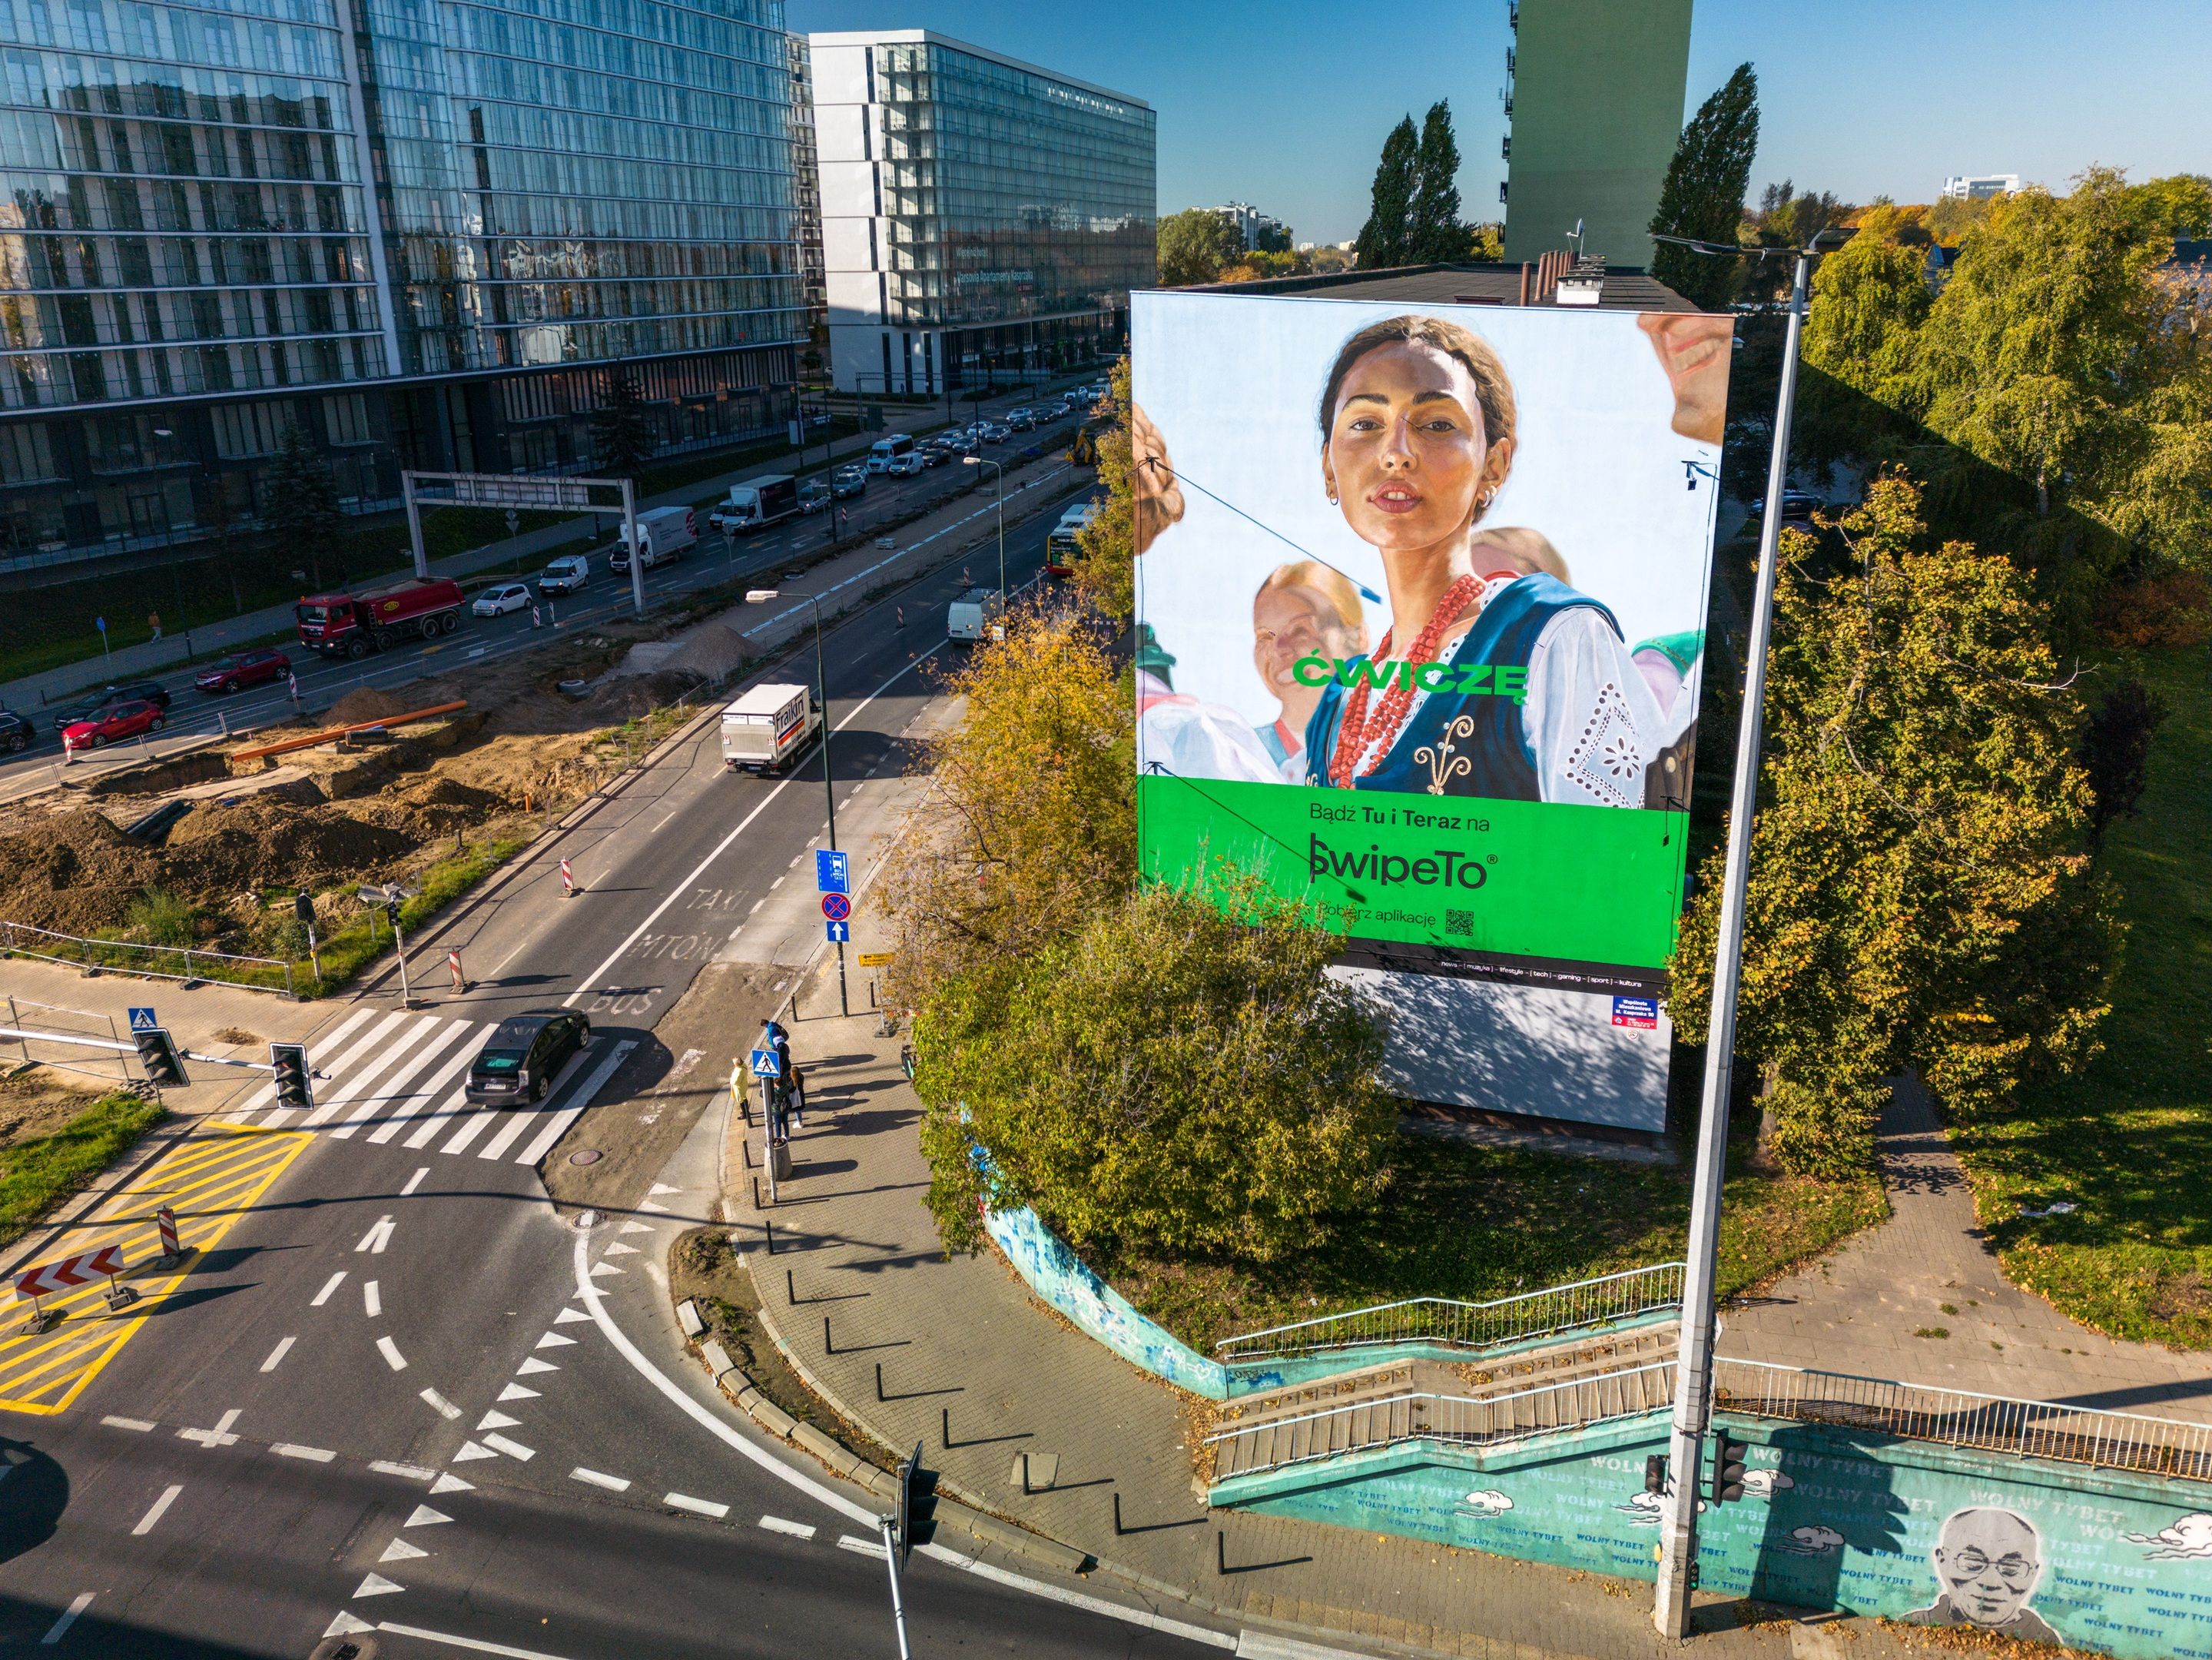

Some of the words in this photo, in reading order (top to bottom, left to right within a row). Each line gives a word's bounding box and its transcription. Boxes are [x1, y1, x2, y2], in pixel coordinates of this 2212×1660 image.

[957, 271, 979, 284] Varsovia
[980, 271, 1010, 283] Apartamenty
[1011, 269, 1033, 283] Kasprzaka
[1292, 648, 1529, 706] ĆWICZĘ
[776, 693, 804, 732] Fraikin
[1310, 803, 1356, 824] Bądź
[1361, 807, 1385, 824] Tu
[1391, 808, 1396, 825] i
[1402, 809, 1461, 830] Teraz
[1467, 818, 1490, 832] na
[686, 888, 749, 911] TAXI
[1375, 909, 1436, 928] aplikację
[627, 935, 722, 960] MTON
[1499, 967, 1524, 975] lifestyle
[1557, 973, 1581, 982] gaming
[585, 986, 662, 1014] BUS
[1591, 1456, 1647, 1475] WOLN
[1753, 1447, 1822, 1469] WOLNY
[1832, 1459, 1897, 1479] TYBET
[1556, 1494, 1603, 1509] WOLNY
[1793, 1483, 1862, 1502] WOLNY
[1872, 1492, 1936, 1512] TYBET
[1357, 1499, 1388, 1510] WOLNY
[1392, 1505, 1421, 1515] TYBET
[1428, 1506, 1458, 1517] WOLN
[1728, 1508, 1774, 1522] TYBET
[1970, 1489, 2044, 1511] WOLNY
[2052, 1501, 2125, 1524] TYBET
[1458, 1536, 1491, 1546] WOLNY
[1498, 1526, 1529, 1537] WOLNY
[1533, 1532, 1564, 1542] TYBET
[2080, 1523, 2125, 1543] WOL
[1577, 1533, 1610, 1544] WOLNY
[1613, 1539, 1645, 1551] TYBET
[1896, 1538, 1936, 1549] WOLN
[1612, 1555, 1644, 1565] WOLNY
[1699, 1547, 1727, 1558] YBET
[1892, 1552, 1927, 1564] TYBET
[1729, 1566, 1764, 1577] WOLNY
[1840, 1569, 1875, 1580] WOLNY
[1879, 1574, 1913, 1586] TYBET
[2055, 1575, 2094, 1588] WOLNY
[2098, 1582, 2134, 1595] TYBET
[2146, 1587, 2185, 1600] WOLNY
[2189, 1594, 2212, 1605] TYB
[2067, 1599, 2104, 1612] TYBET
[2147, 1606, 2188, 1619] WOLNY
[2084, 1618, 2122, 1631] WOLNY
[2126, 1625, 2164, 1638] TYBET
